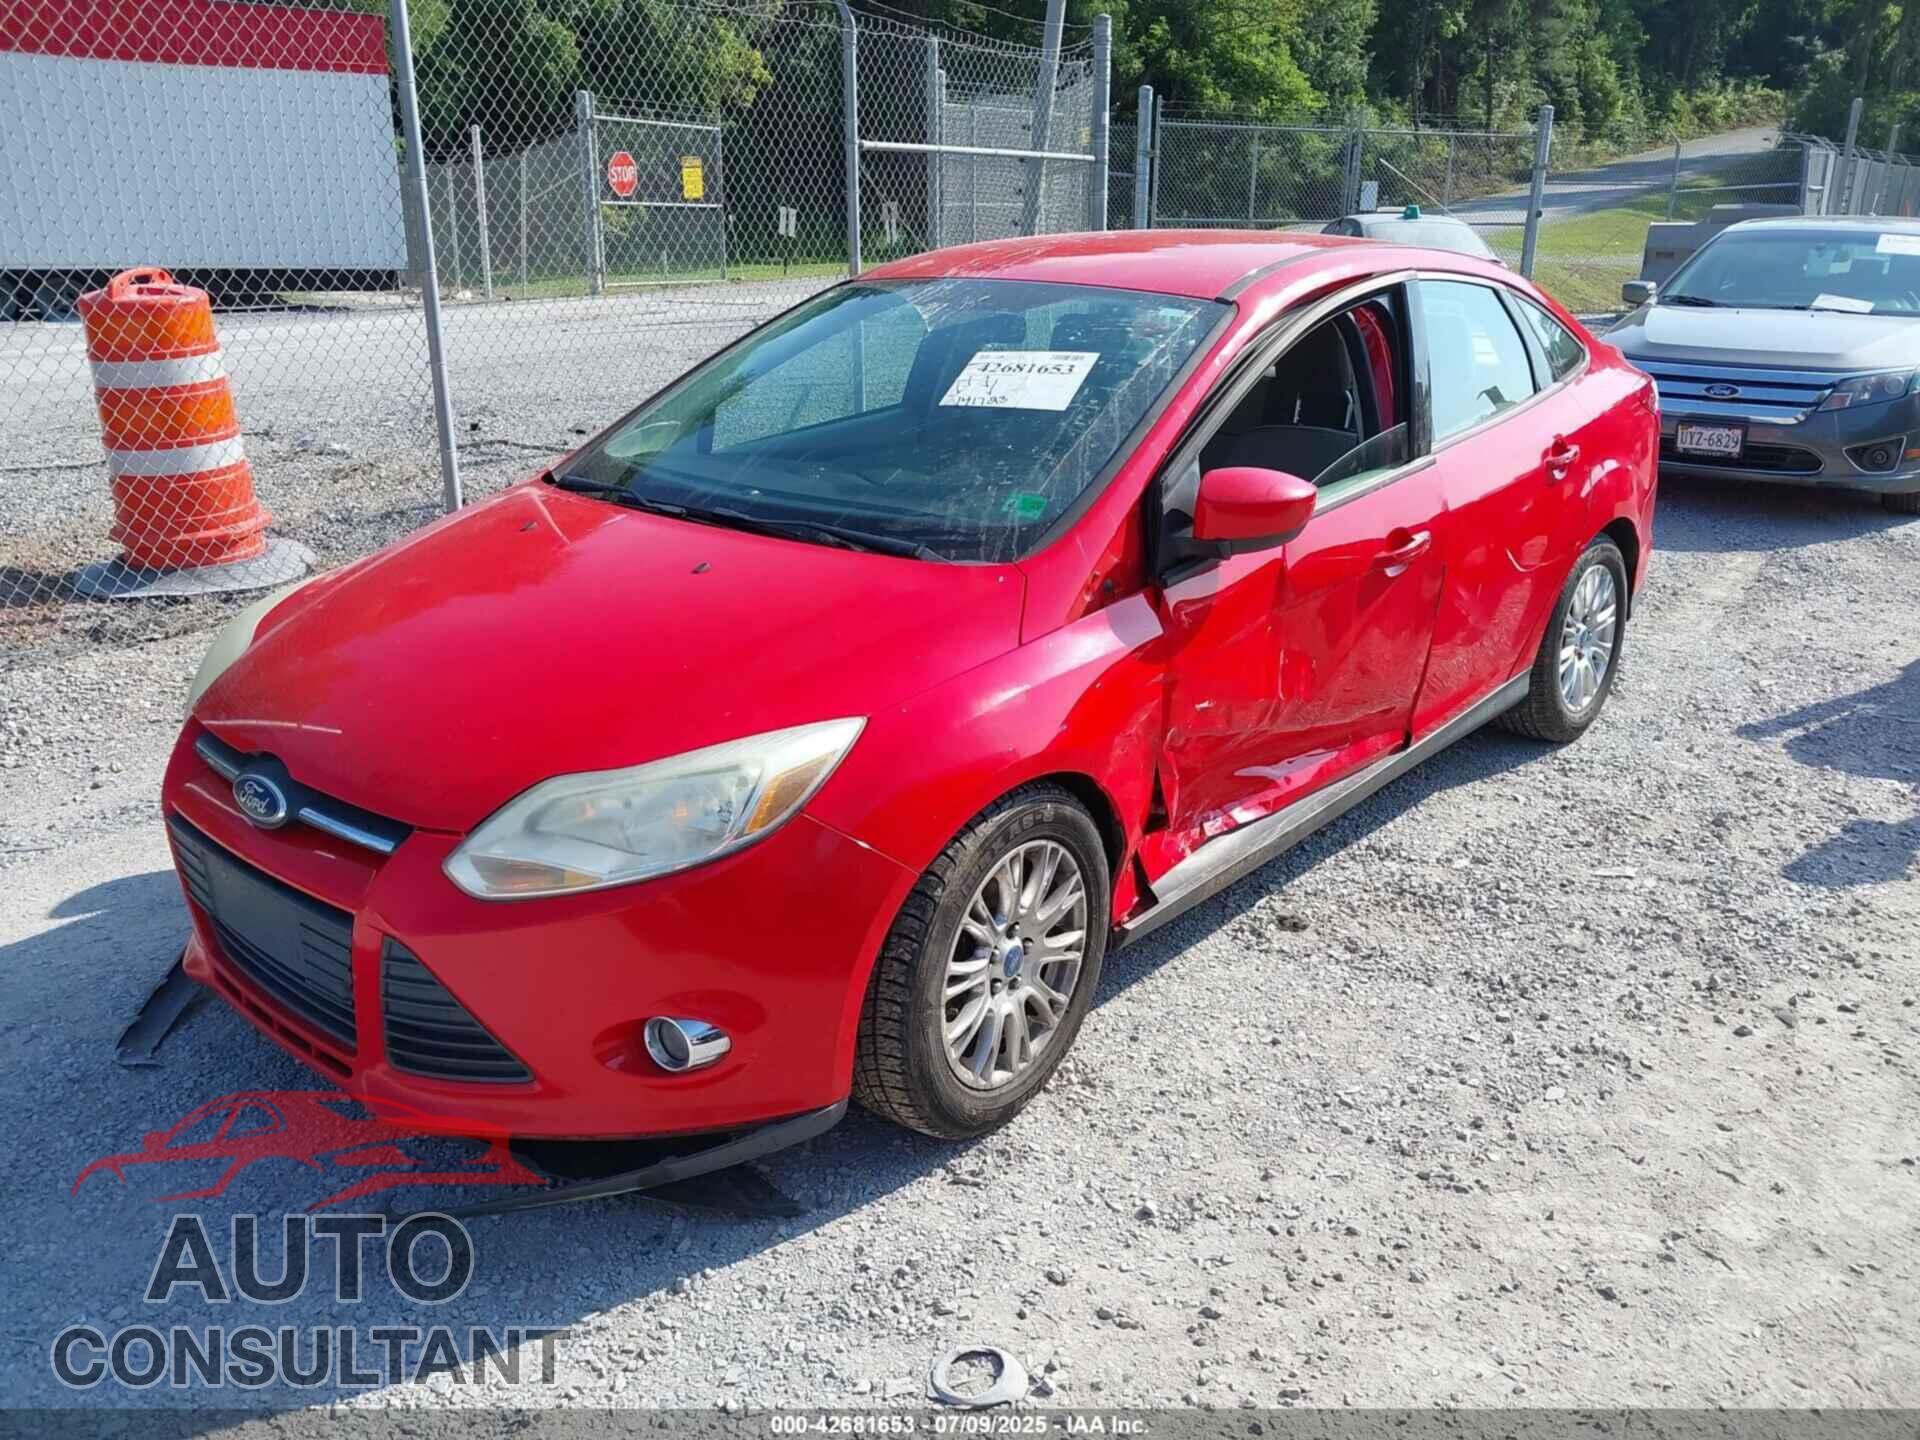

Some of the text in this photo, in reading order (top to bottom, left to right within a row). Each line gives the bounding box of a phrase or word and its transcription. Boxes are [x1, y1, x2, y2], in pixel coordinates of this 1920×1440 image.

[611, 166, 635, 182] STOP
[976, 361, 1076, 376] 42681653
[239, 780, 269, 814] Ford
